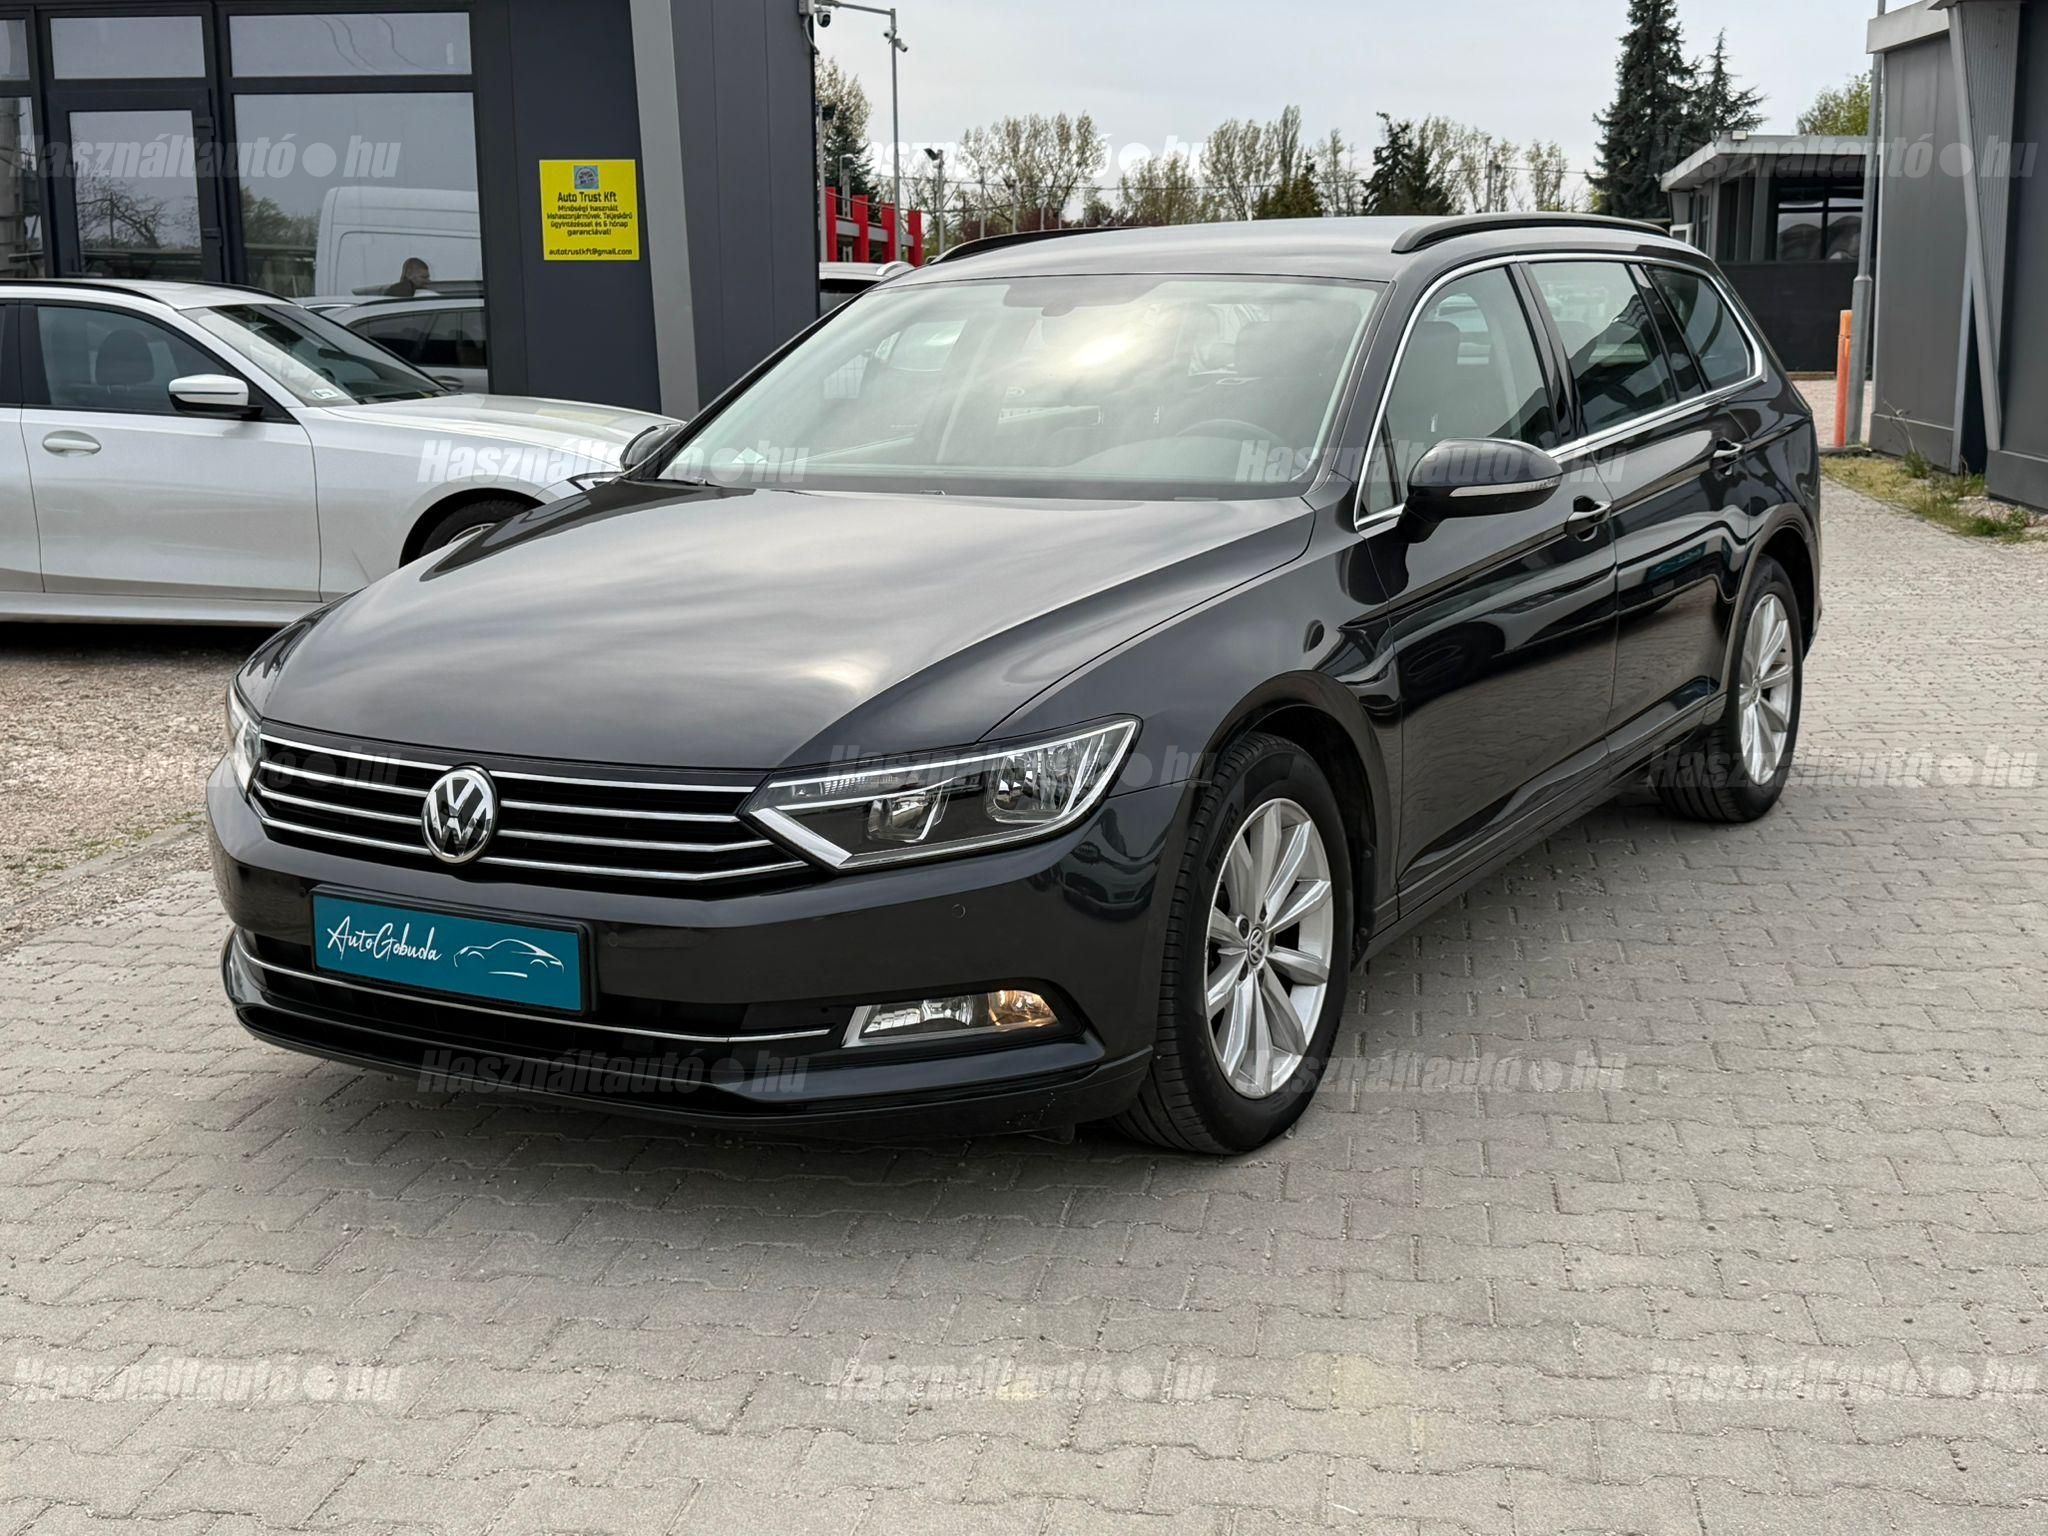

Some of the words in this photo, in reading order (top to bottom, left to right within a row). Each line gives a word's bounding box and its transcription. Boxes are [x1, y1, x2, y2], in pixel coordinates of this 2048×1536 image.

[557, 192, 577, 202] Auto
[579, 192, 602, 203] Trust
[603, 192, 617, 203] Kft
